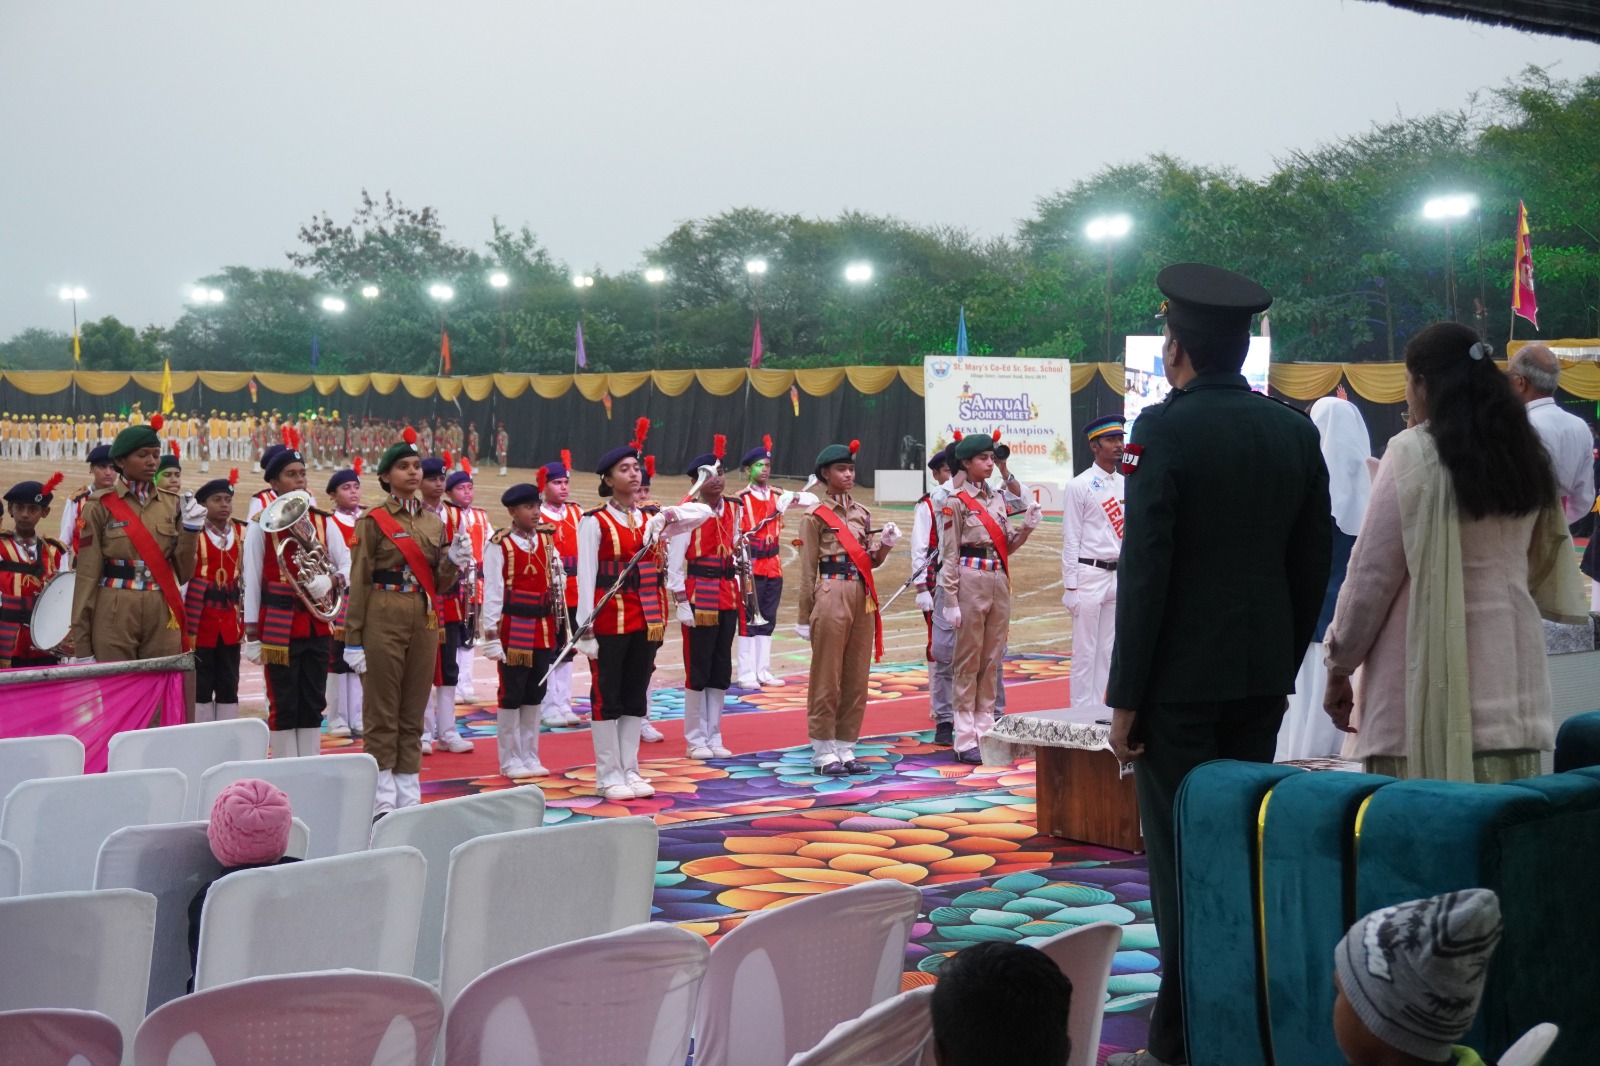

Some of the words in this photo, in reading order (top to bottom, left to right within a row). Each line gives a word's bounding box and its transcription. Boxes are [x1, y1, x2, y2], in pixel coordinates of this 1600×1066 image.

[965, 364, 988, 373] Mary's
[990, 364, 1010, 372] Co-Ed
[1023, 365, 1038, 373] Sec.
[1040, 365, 1063, 373] School
[971, 393, 1030, 411] ANNUAL
[959, 403, 1003, 421] SPORTS
[1004, 411, 1030, 421] MEET
[982, 424, 993, 434] of
[1032, 488, 1040, 504] 1
